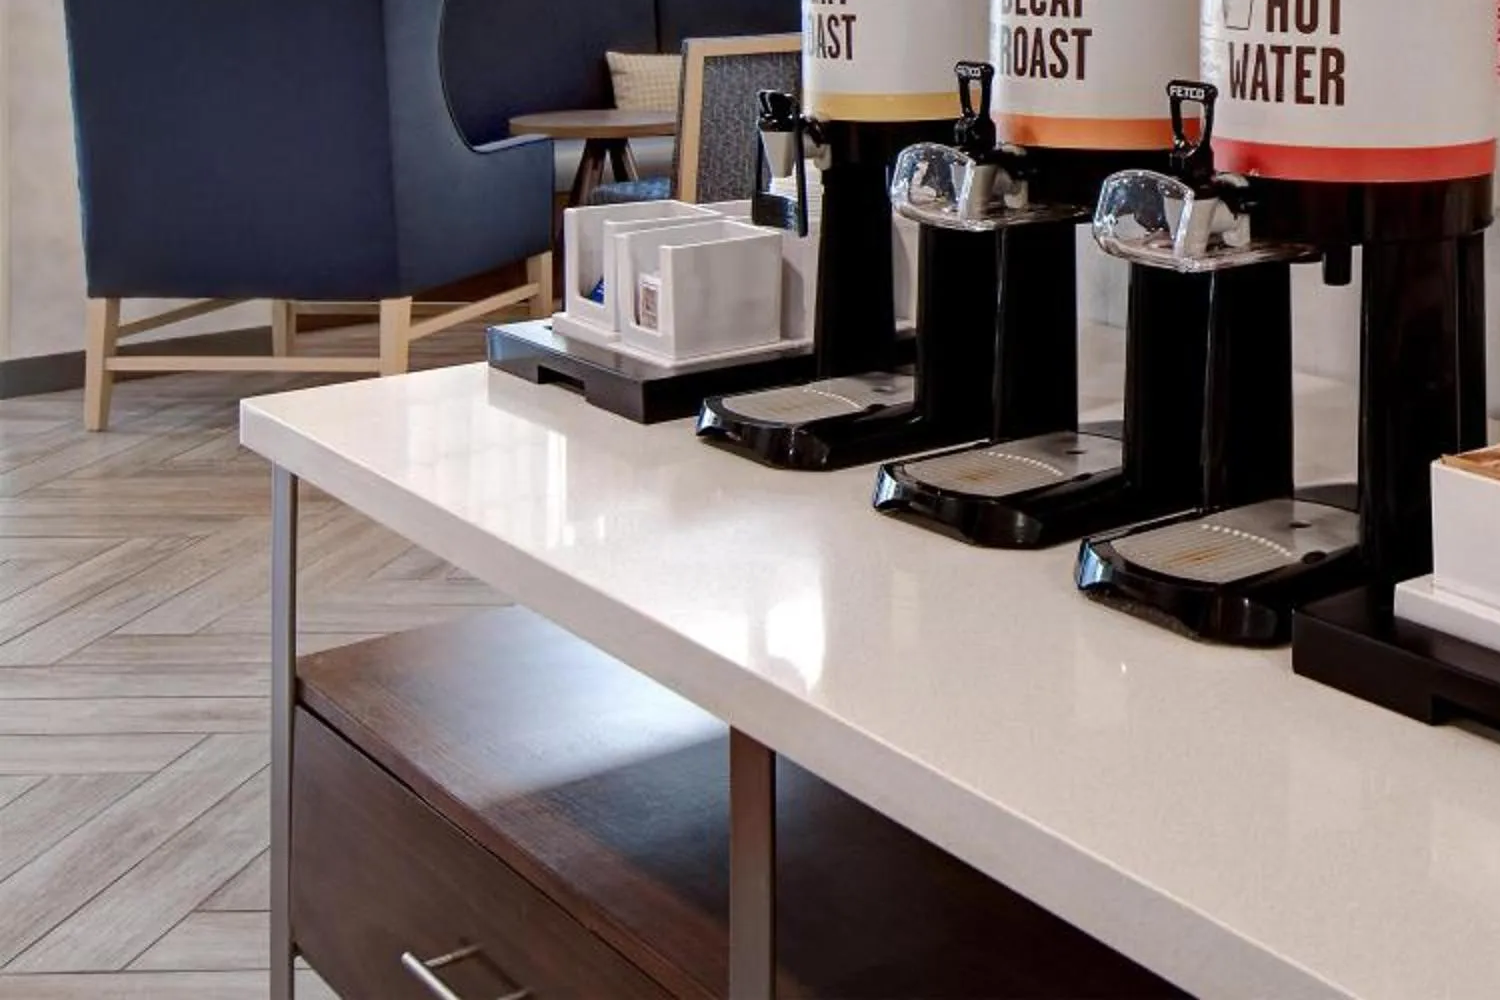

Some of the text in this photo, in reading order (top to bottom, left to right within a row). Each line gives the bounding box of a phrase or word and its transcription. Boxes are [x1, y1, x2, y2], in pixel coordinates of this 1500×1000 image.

[807, 13, 857, 60] OAST
[999, 25, 1093, 81] ROAST
[1228, 41, 1346, 106] WATER
